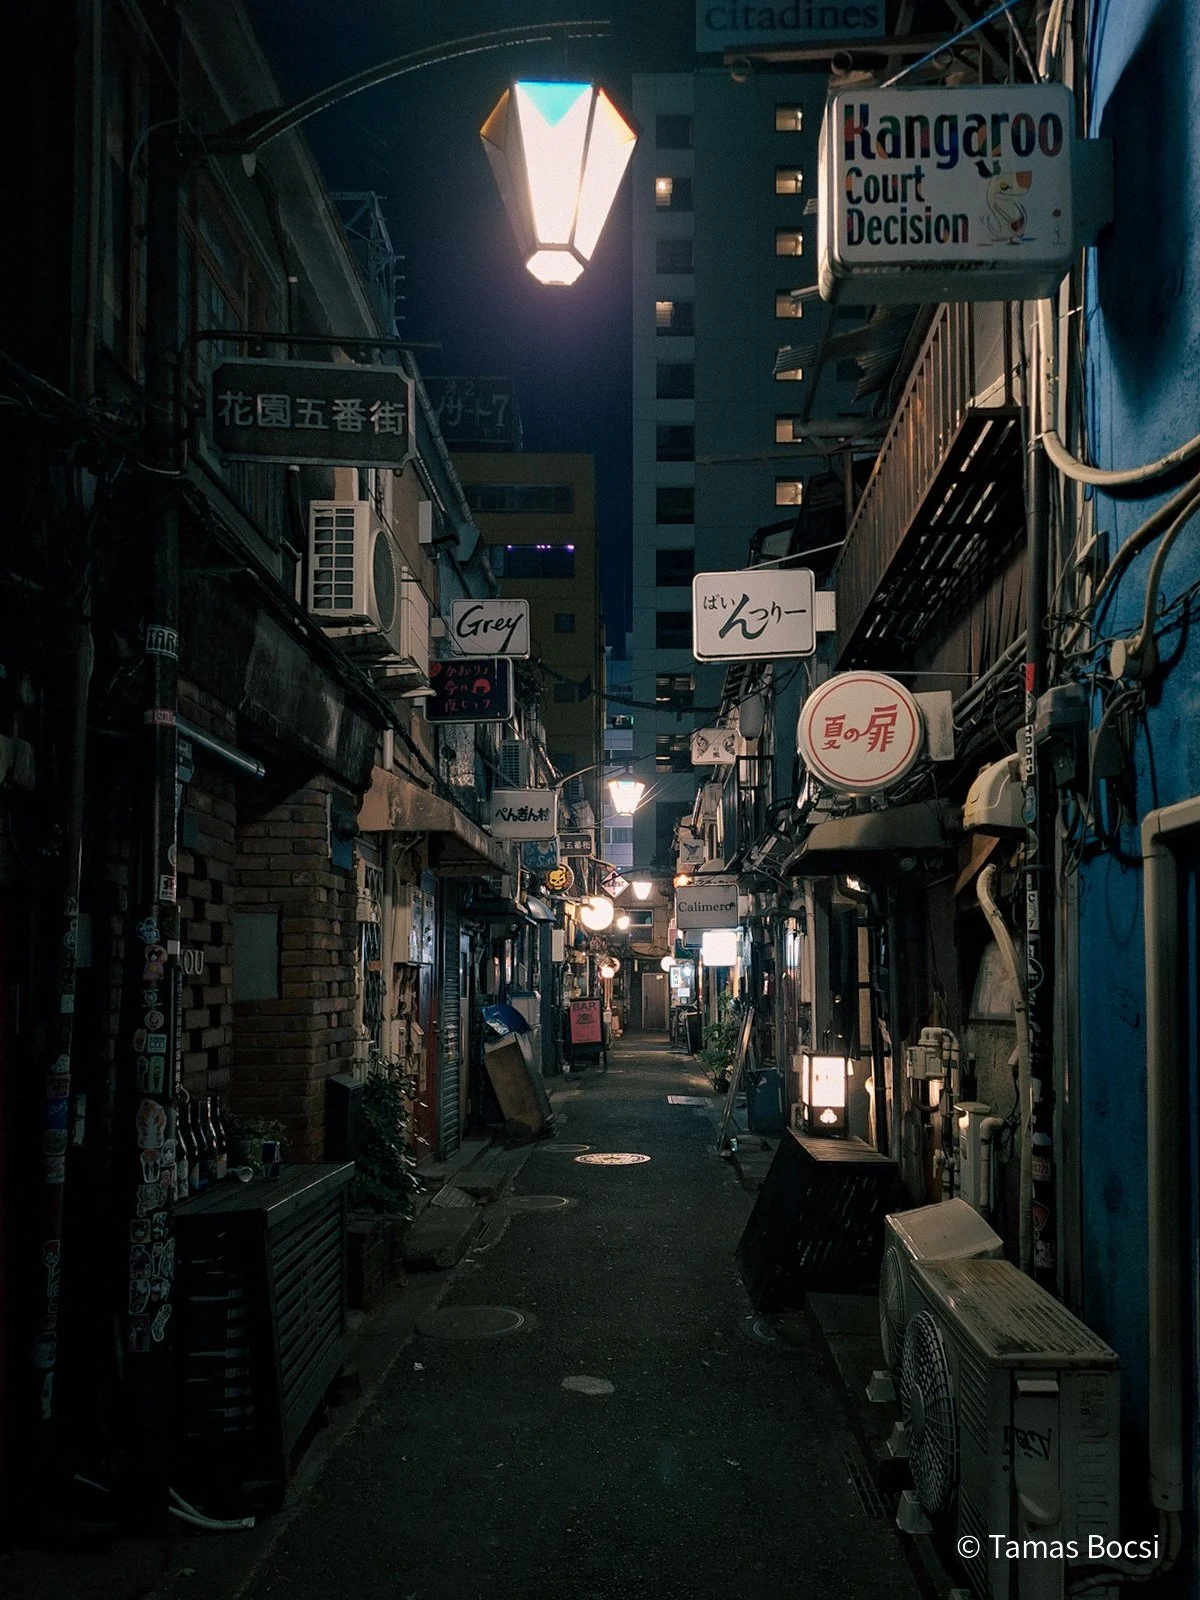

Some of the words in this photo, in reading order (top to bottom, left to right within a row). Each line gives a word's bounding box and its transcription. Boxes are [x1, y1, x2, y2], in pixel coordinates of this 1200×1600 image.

[704, 0, 878, 30] citadines
[844, 104, 1063, 170] Kangaroo
[845, 165, 926, 205] Court
[847, 207, 969, 246] Decision
[217, 389, 406, 437] 花園五番街
[456, 604, 524, 652] Grey
[820, 703, 898, 753] 夏の扉
[678, 901, 734, 913] Calimero
[573, 1001, 597, 1011] BAR
